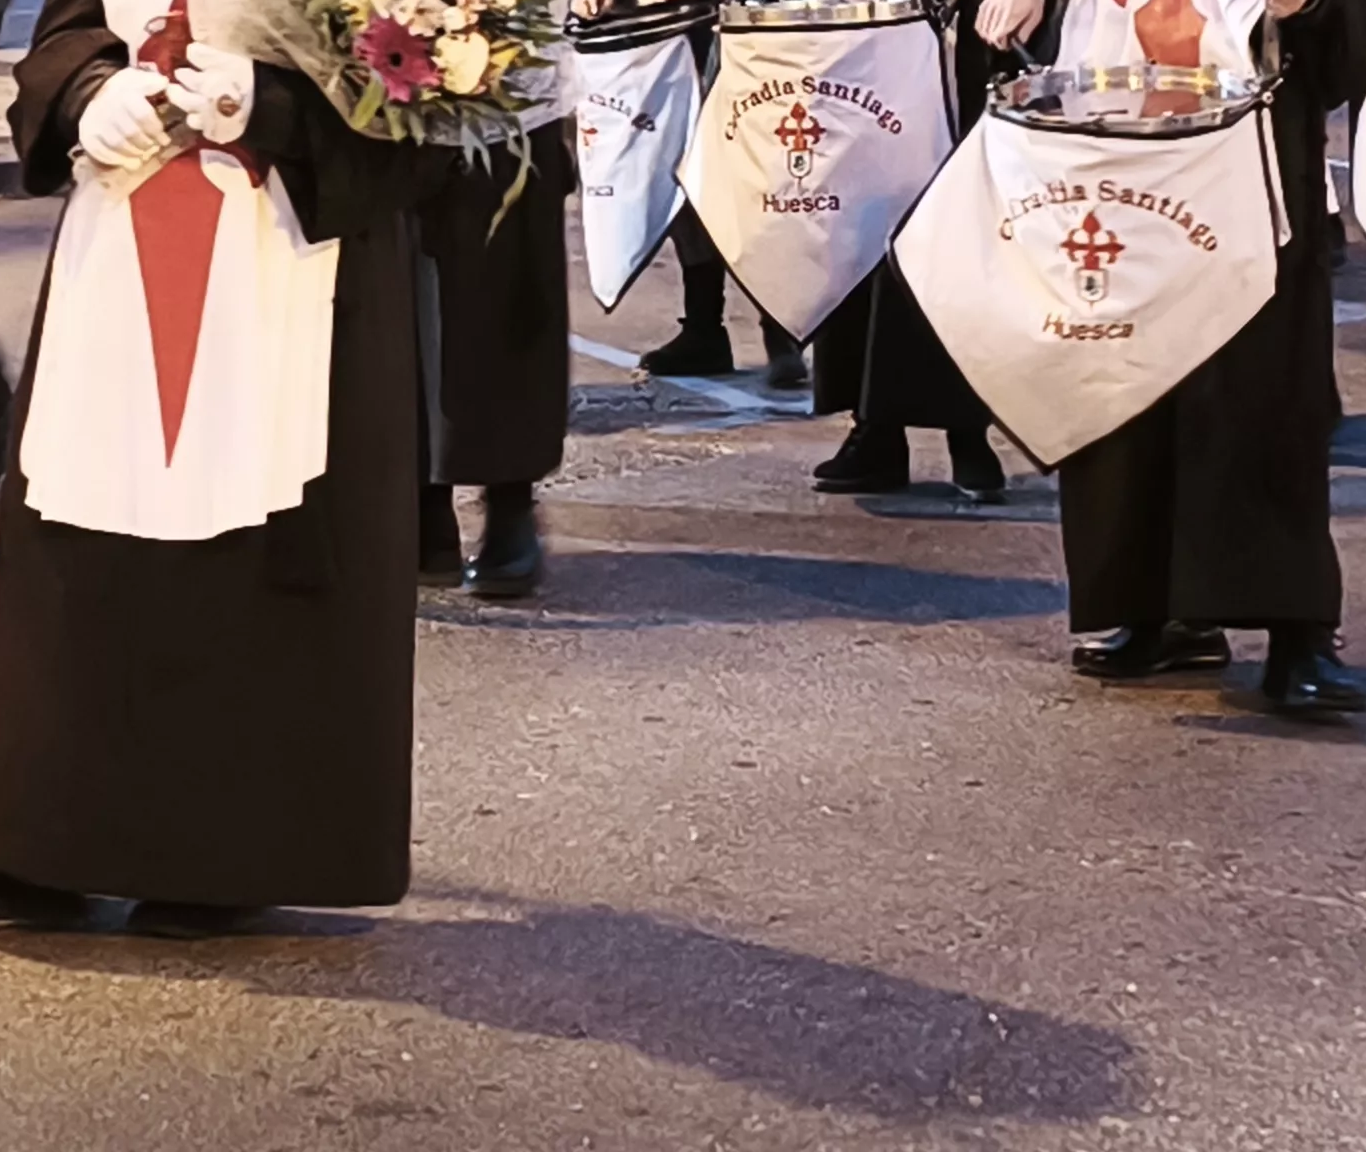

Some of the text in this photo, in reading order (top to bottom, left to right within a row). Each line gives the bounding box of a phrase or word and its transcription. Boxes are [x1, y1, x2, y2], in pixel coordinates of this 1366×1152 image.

[801, 75, 903, 135] Santiago
[761, 193, 840, 214] Huesca
[1097, 178, 1219, 252] Santiago
[1041, 312, 1134, 341] Huesca
